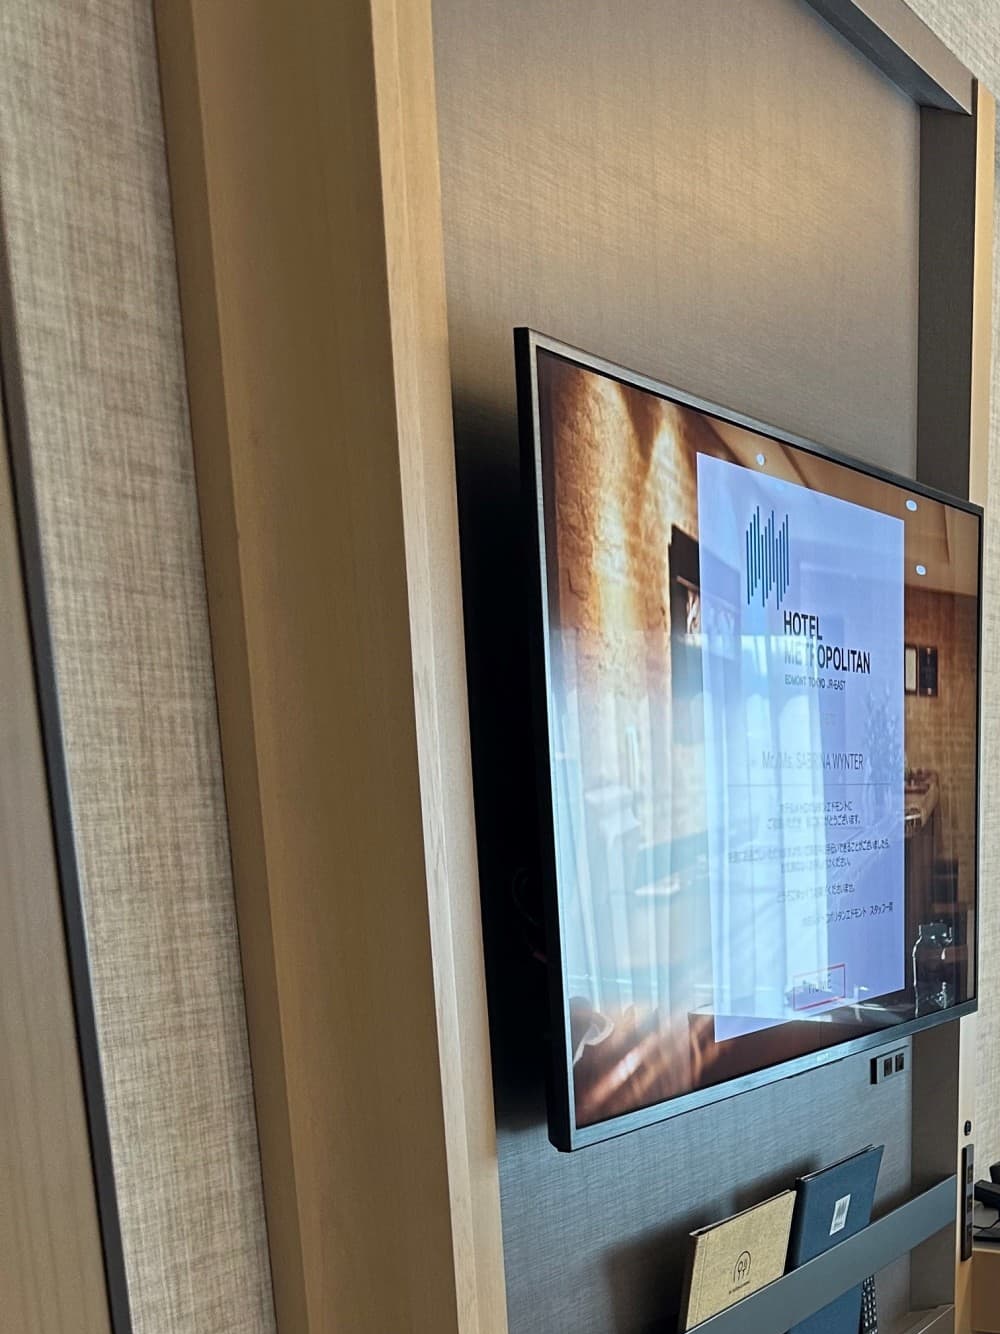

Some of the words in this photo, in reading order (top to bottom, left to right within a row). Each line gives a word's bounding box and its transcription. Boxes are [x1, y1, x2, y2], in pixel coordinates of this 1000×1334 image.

[783, 610, 823, 640] HOTEL
[795, 751, 831, 770] SABNA
[832, 752, 864, 771] WYNTER
